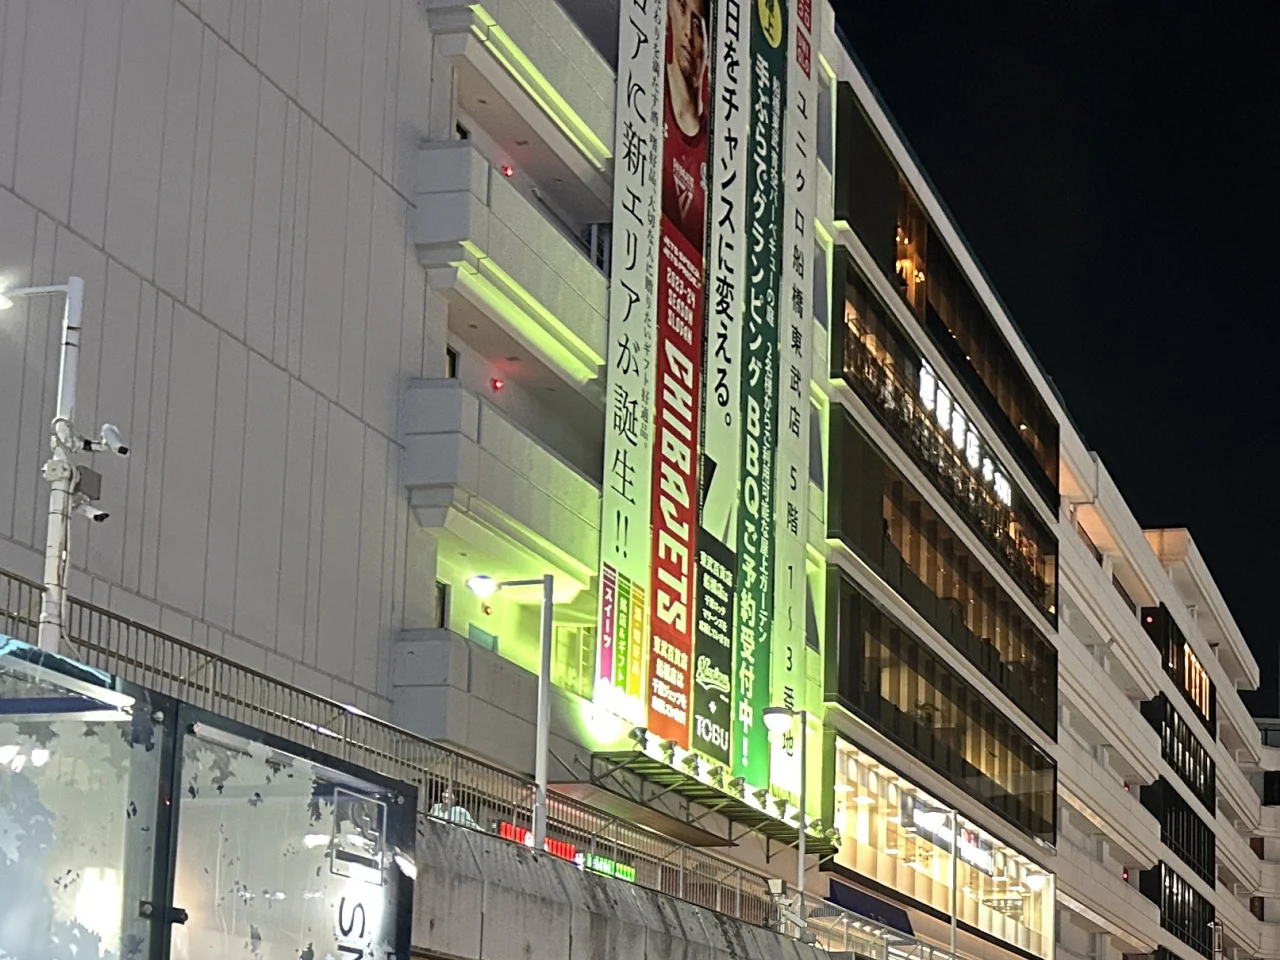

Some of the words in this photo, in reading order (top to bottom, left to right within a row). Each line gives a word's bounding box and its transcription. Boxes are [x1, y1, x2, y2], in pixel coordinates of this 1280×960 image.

[603, 587, 613, 648] スイーツ
[695, 715, 728, 751] TOBU
